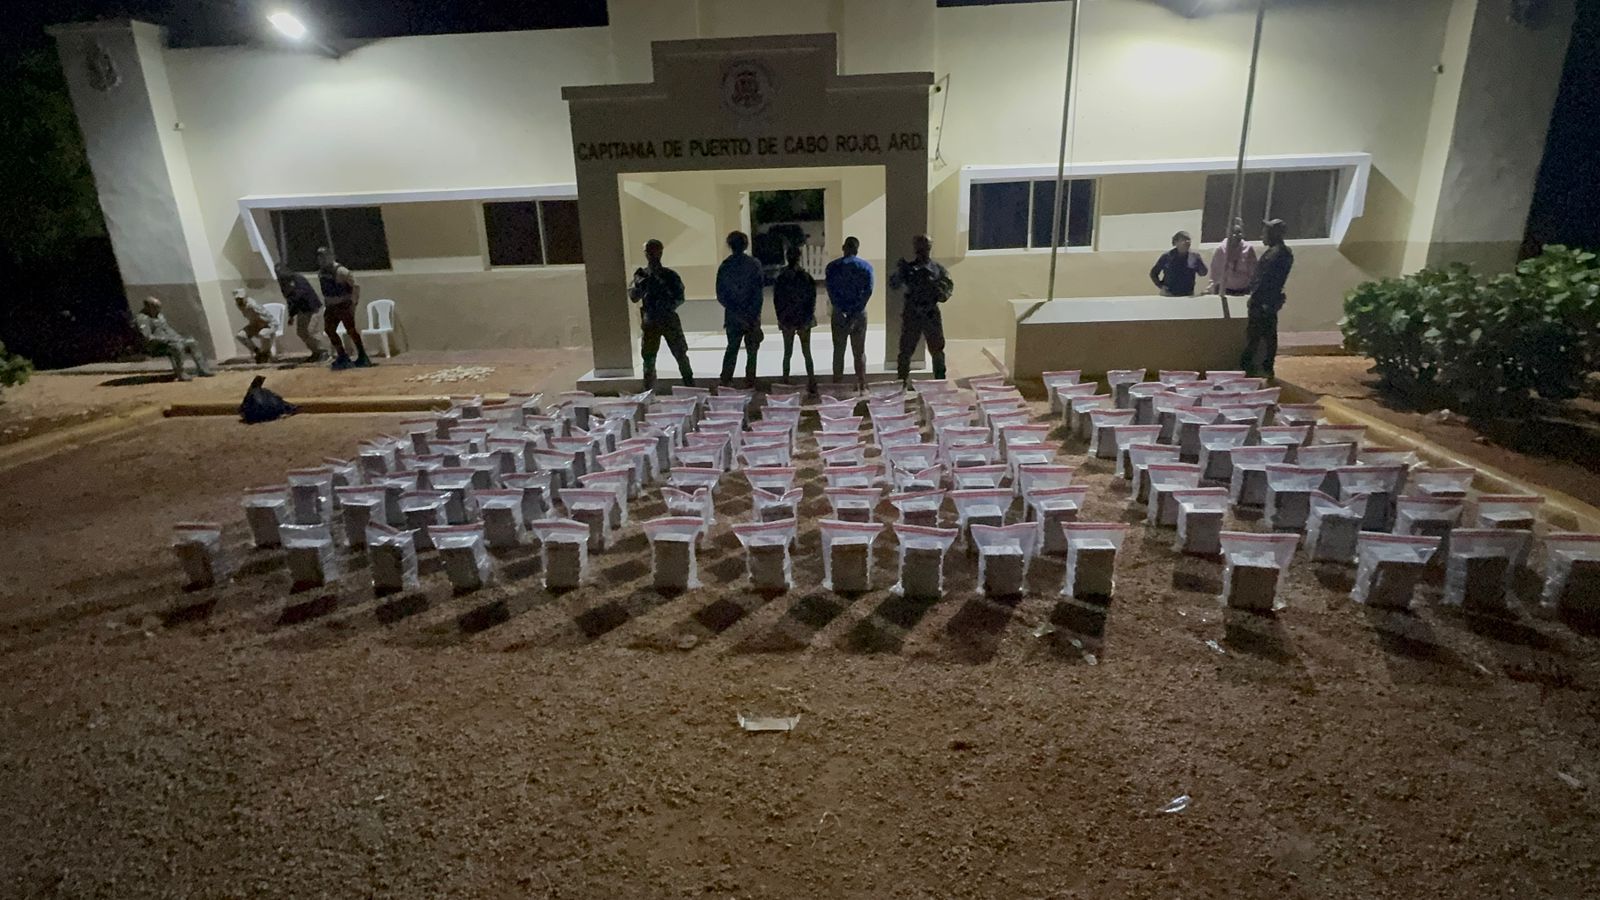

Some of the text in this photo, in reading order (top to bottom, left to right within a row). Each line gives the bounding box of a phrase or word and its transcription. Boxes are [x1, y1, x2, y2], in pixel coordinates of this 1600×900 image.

[663, 140, 683, 157] DE
[689, 138, 751, 157] PUERTO
[758, 137, 778, 155] DE
[784, 135, 829, 154] CABO
[836, 134, 881, 154] ROJO,
[888, 132, 925, 152] ARD.
